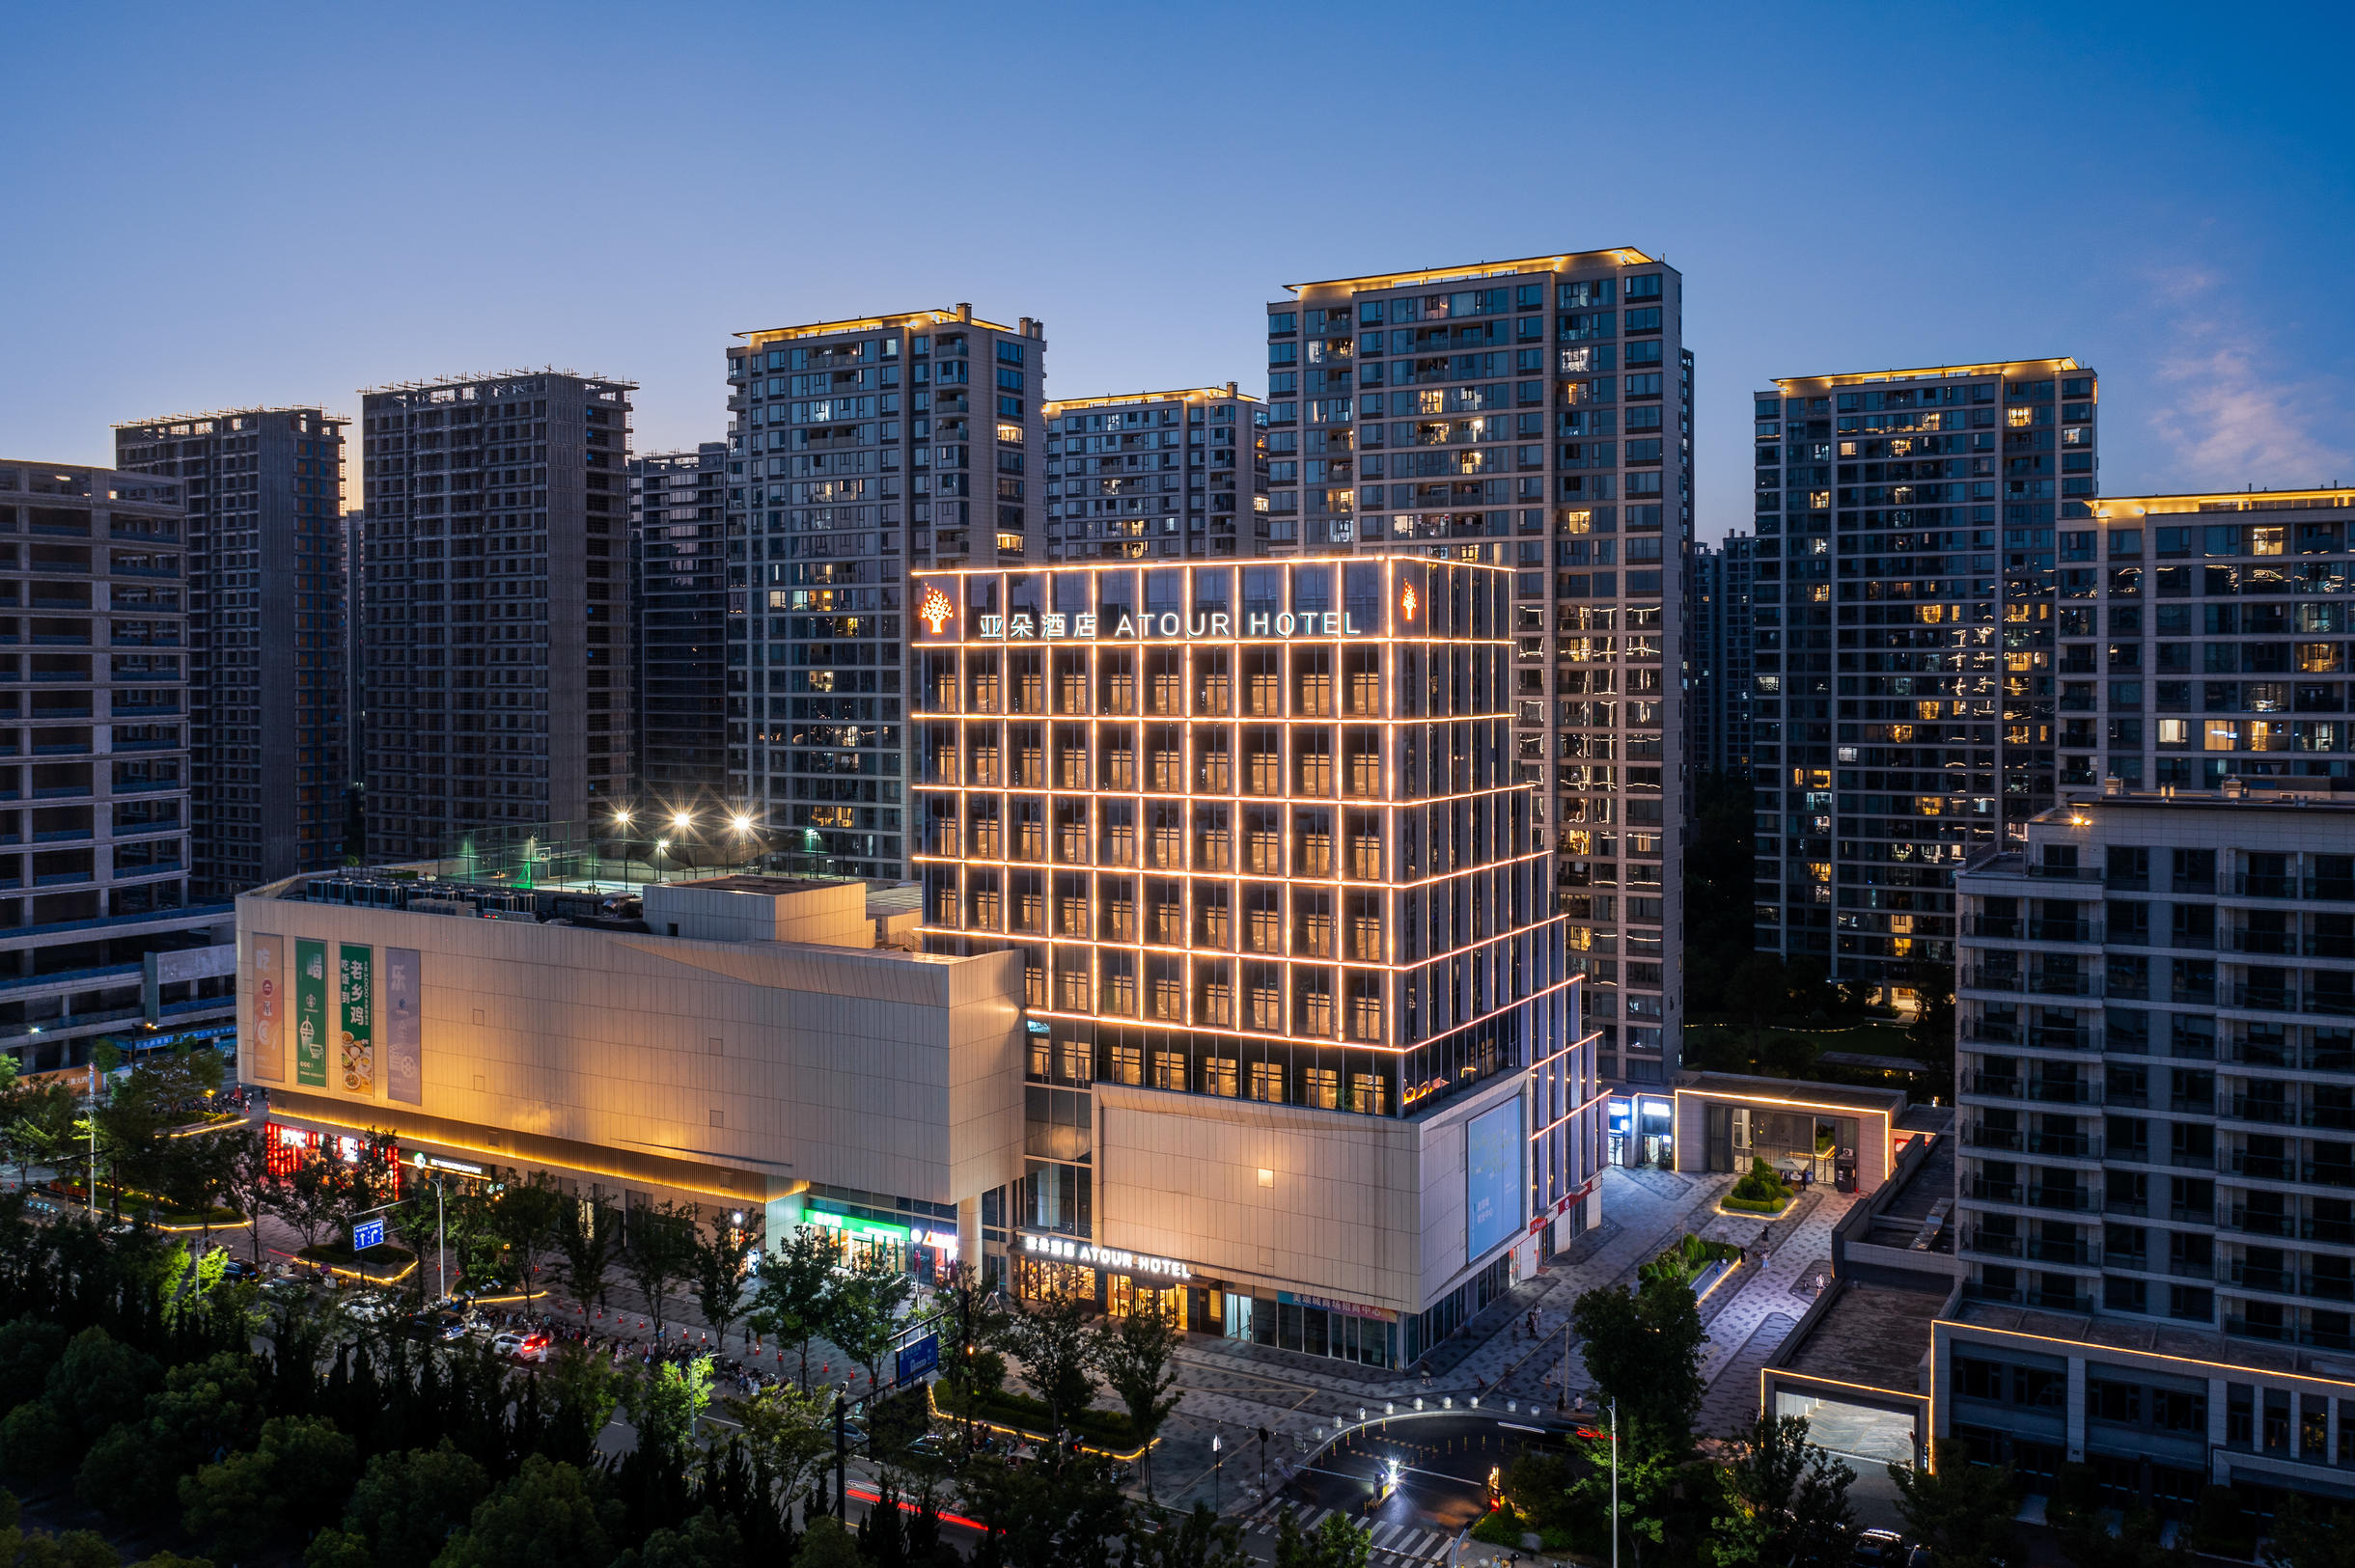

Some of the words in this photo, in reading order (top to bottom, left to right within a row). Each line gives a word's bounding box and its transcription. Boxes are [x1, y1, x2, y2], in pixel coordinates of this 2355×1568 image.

[980, 613, 1097, 639] 亚朵酒店
[1115, 613, 1231, 637] ATOUR
[1251, 612, 1361, 636] HOTEL
[350, 960, 364, 1026] 老乡鸡
[1080, 1246, 1133, 1268] ATOUR
[1138, 1256, 1191, 1279] HOTEL
